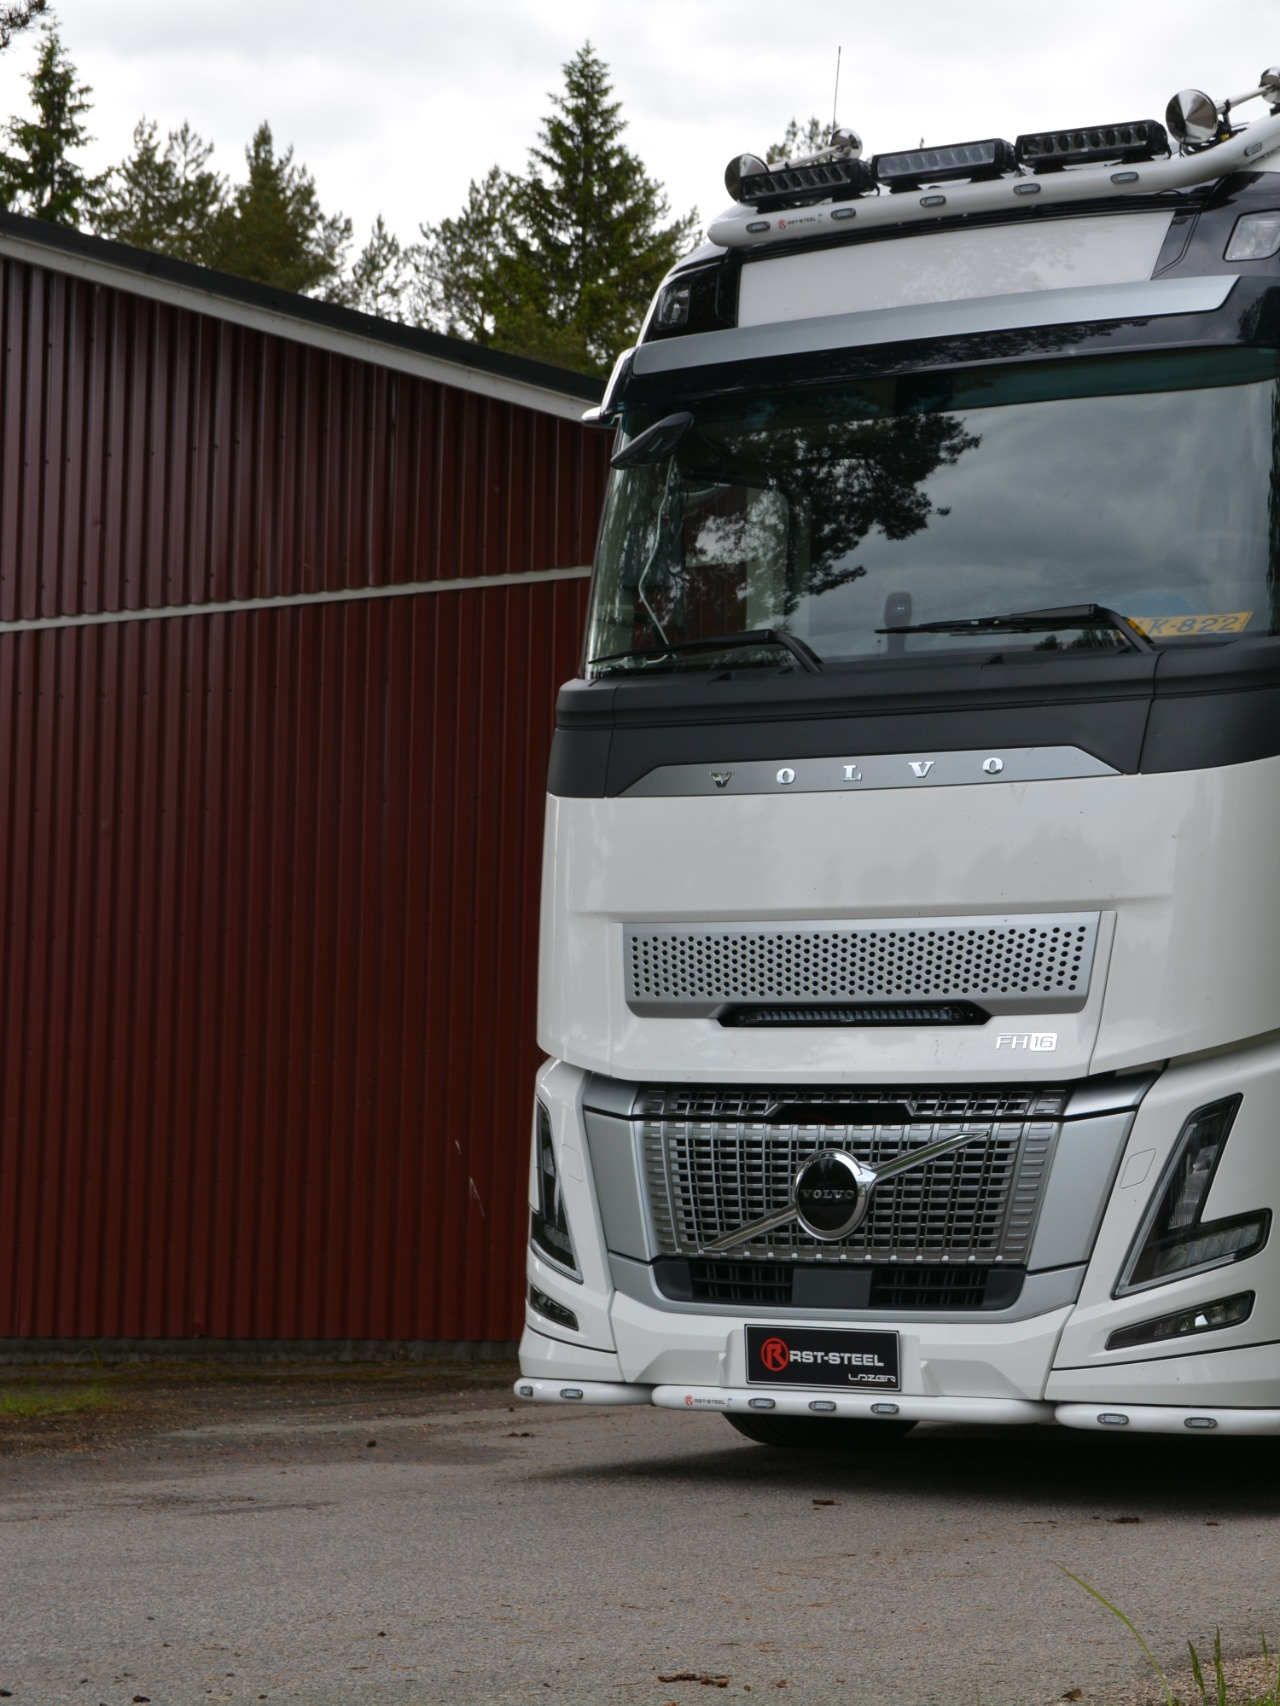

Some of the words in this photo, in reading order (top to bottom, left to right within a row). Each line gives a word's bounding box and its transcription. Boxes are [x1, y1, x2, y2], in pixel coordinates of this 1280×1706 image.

[709, 757, 1004, 788] VOLVO
[996, 1032, 1057, 1052] FH16
[801, 1189, 855, 1199] VOLVO
[789, 1350, 884, 1367] RST-STEEL
